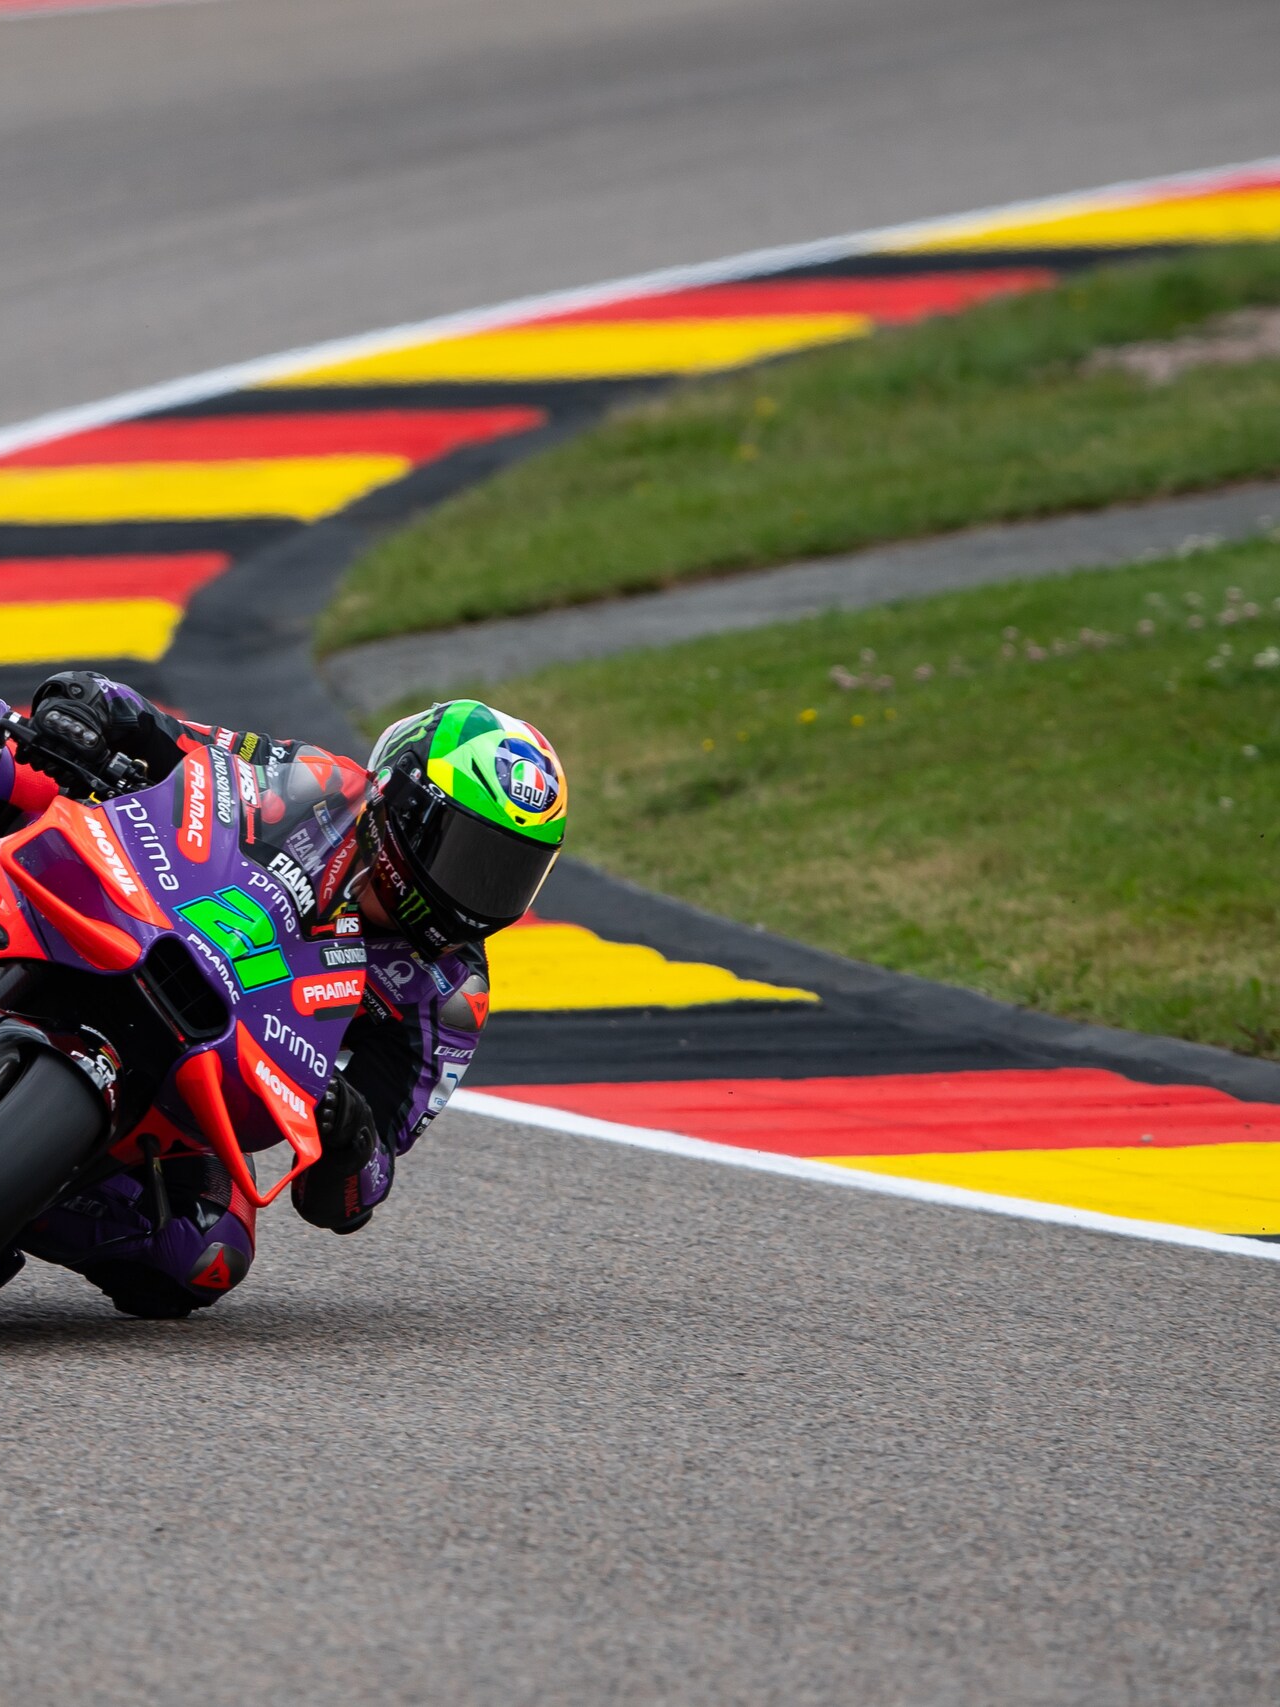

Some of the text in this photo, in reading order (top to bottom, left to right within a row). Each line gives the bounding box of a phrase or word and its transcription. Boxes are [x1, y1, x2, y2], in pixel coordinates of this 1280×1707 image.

[187, 759, 205, 847] PRAMAC
[238, 757, 258, 806] WRS
[513, 780, 545, 810] agv
[83, 815, 139, 898] MOTUL
[115, 797, 180, 891] prima
[247, 871, 297, 933] prima
[270, 852, 317, 915] FIAMM
[172, 884, 295, 994] 21
[335, 917, 360, 934] WRS
[186, 933, 241, 1005] PRAMAC
[302, 979, 361, 1004] PRAMAC
[370, 963, 404, 1002] PRAMAC
[263, 1014, 328, 1078] prima
[255, 1059, 309, 1120] MOTUL
